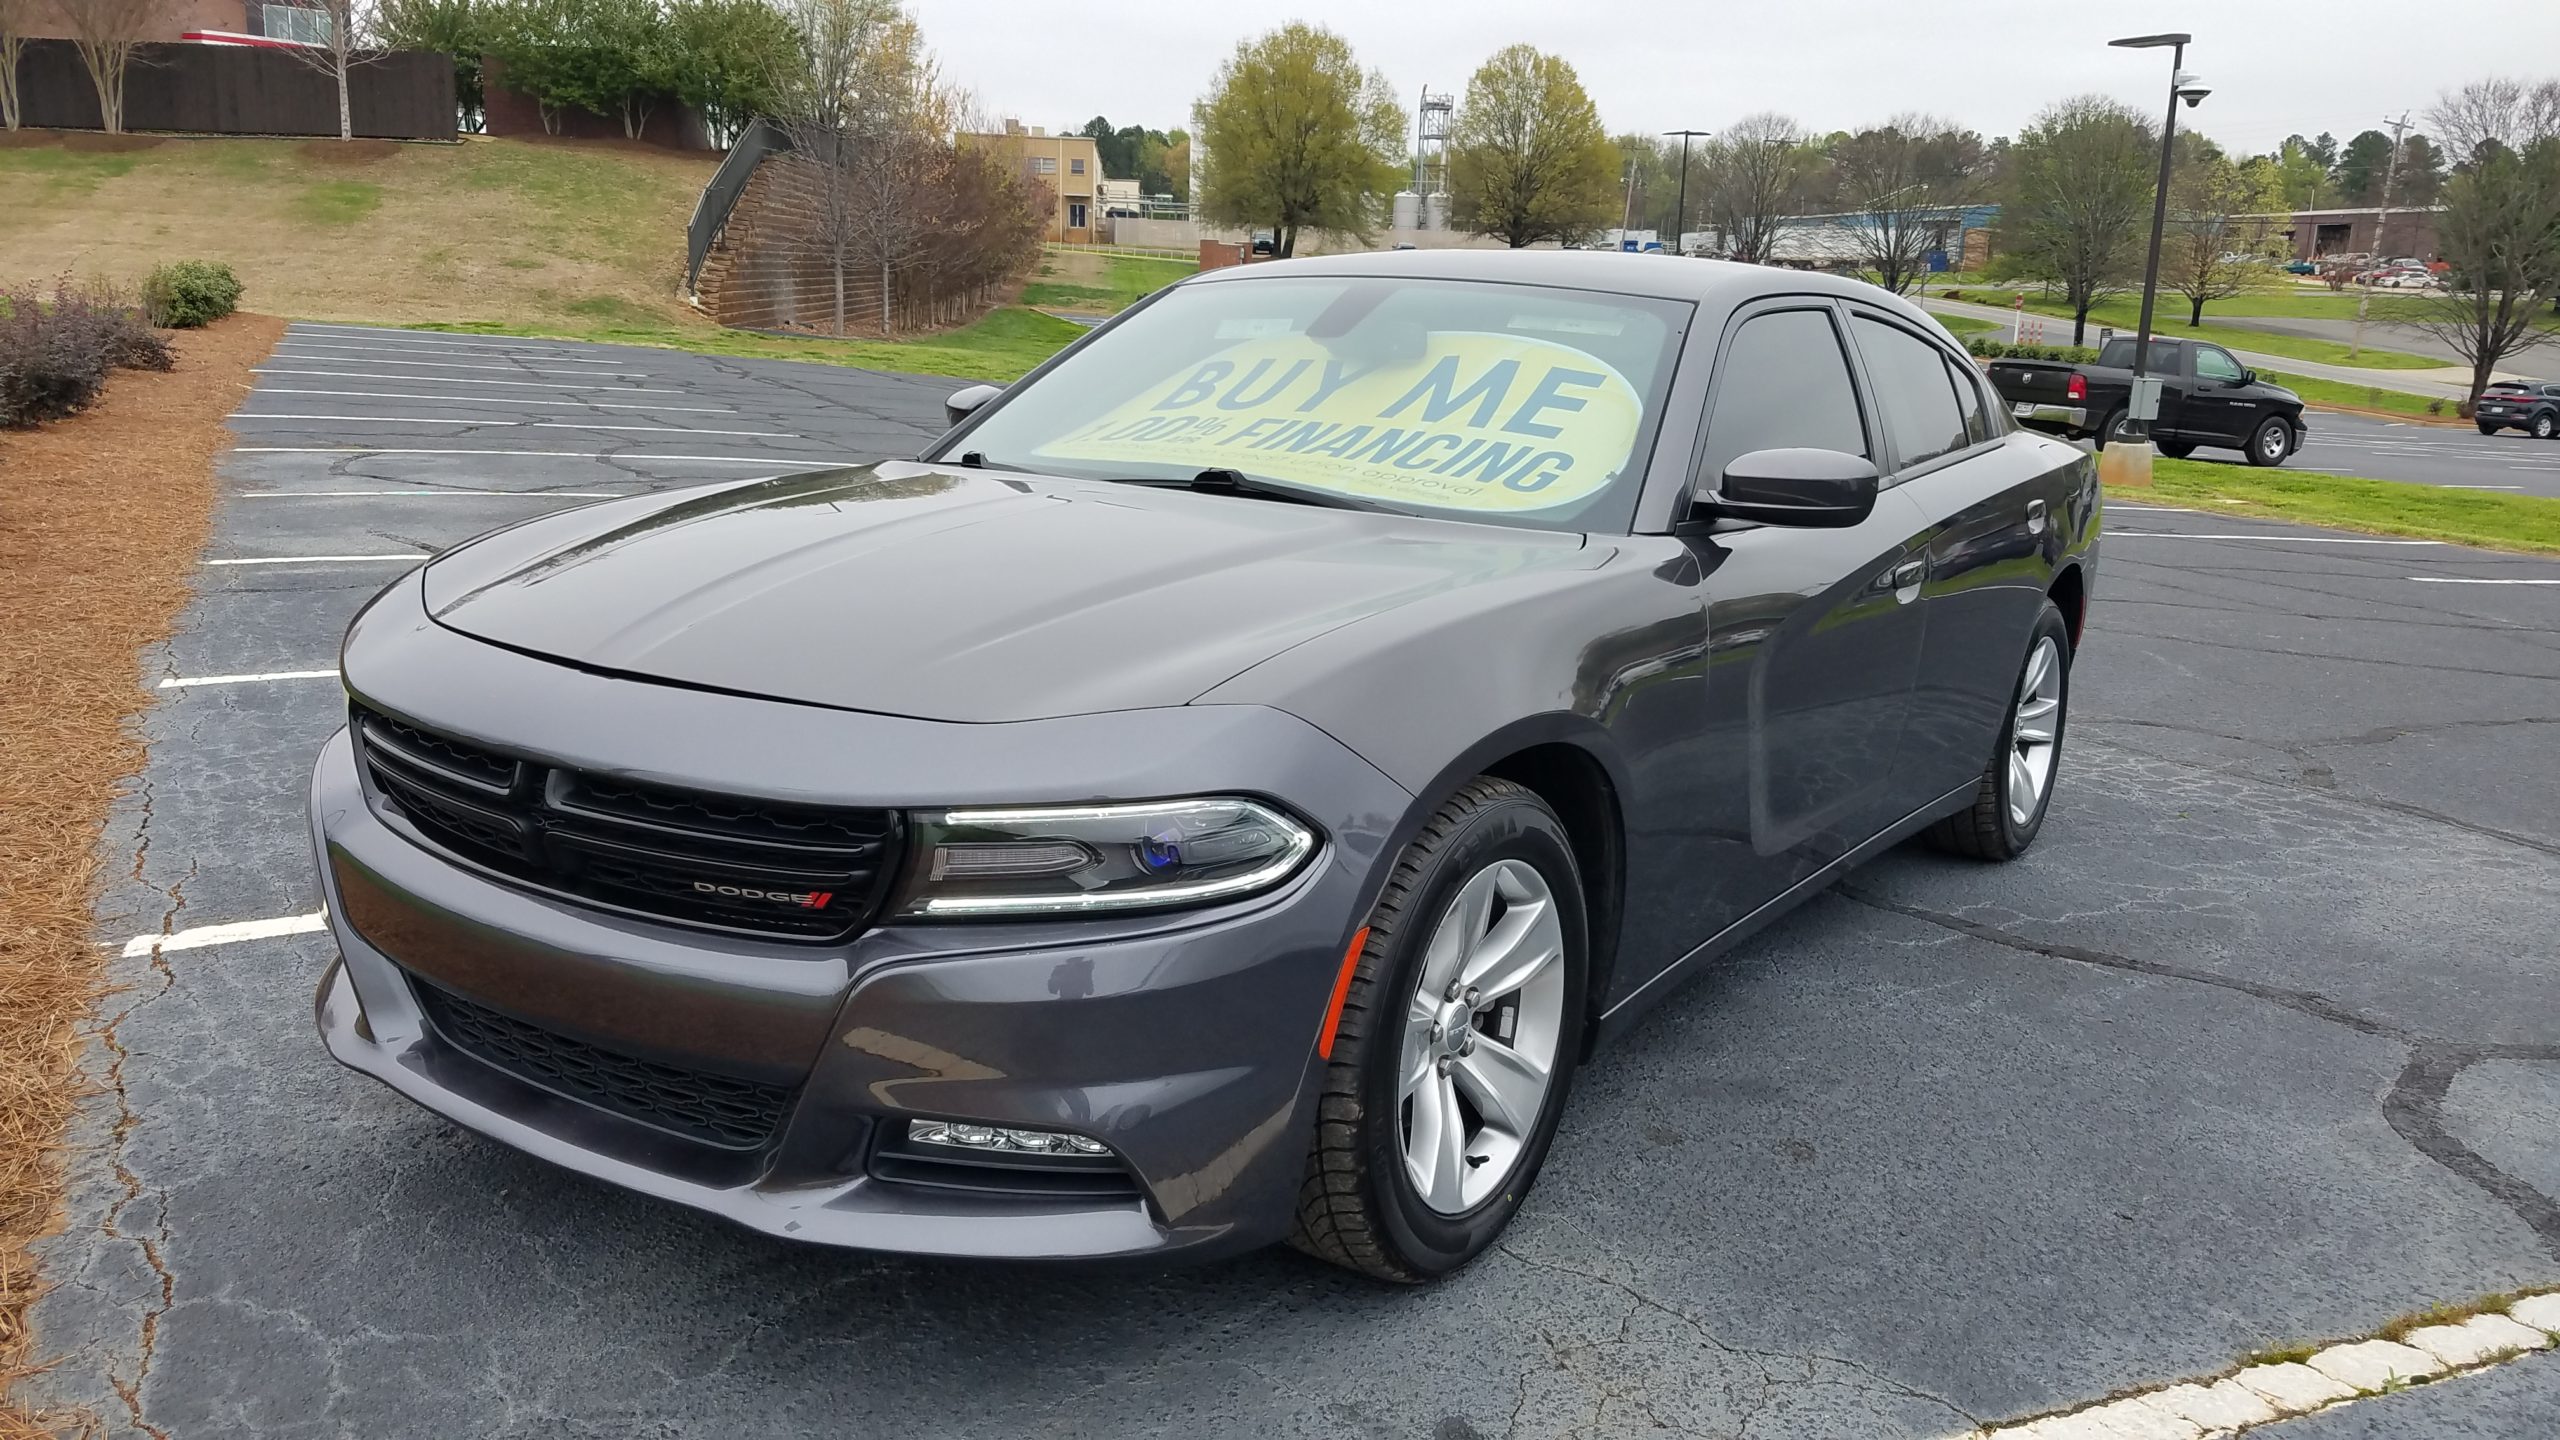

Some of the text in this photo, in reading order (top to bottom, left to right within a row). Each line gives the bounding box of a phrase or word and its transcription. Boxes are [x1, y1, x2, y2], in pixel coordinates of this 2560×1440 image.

[1150, 355, 1608, 440] BUY ME
[1213, 417, 1575, 493] FINANCING
[1362, 469, 1485, 497] approval
[693, 881, 814, 905] DODGE
